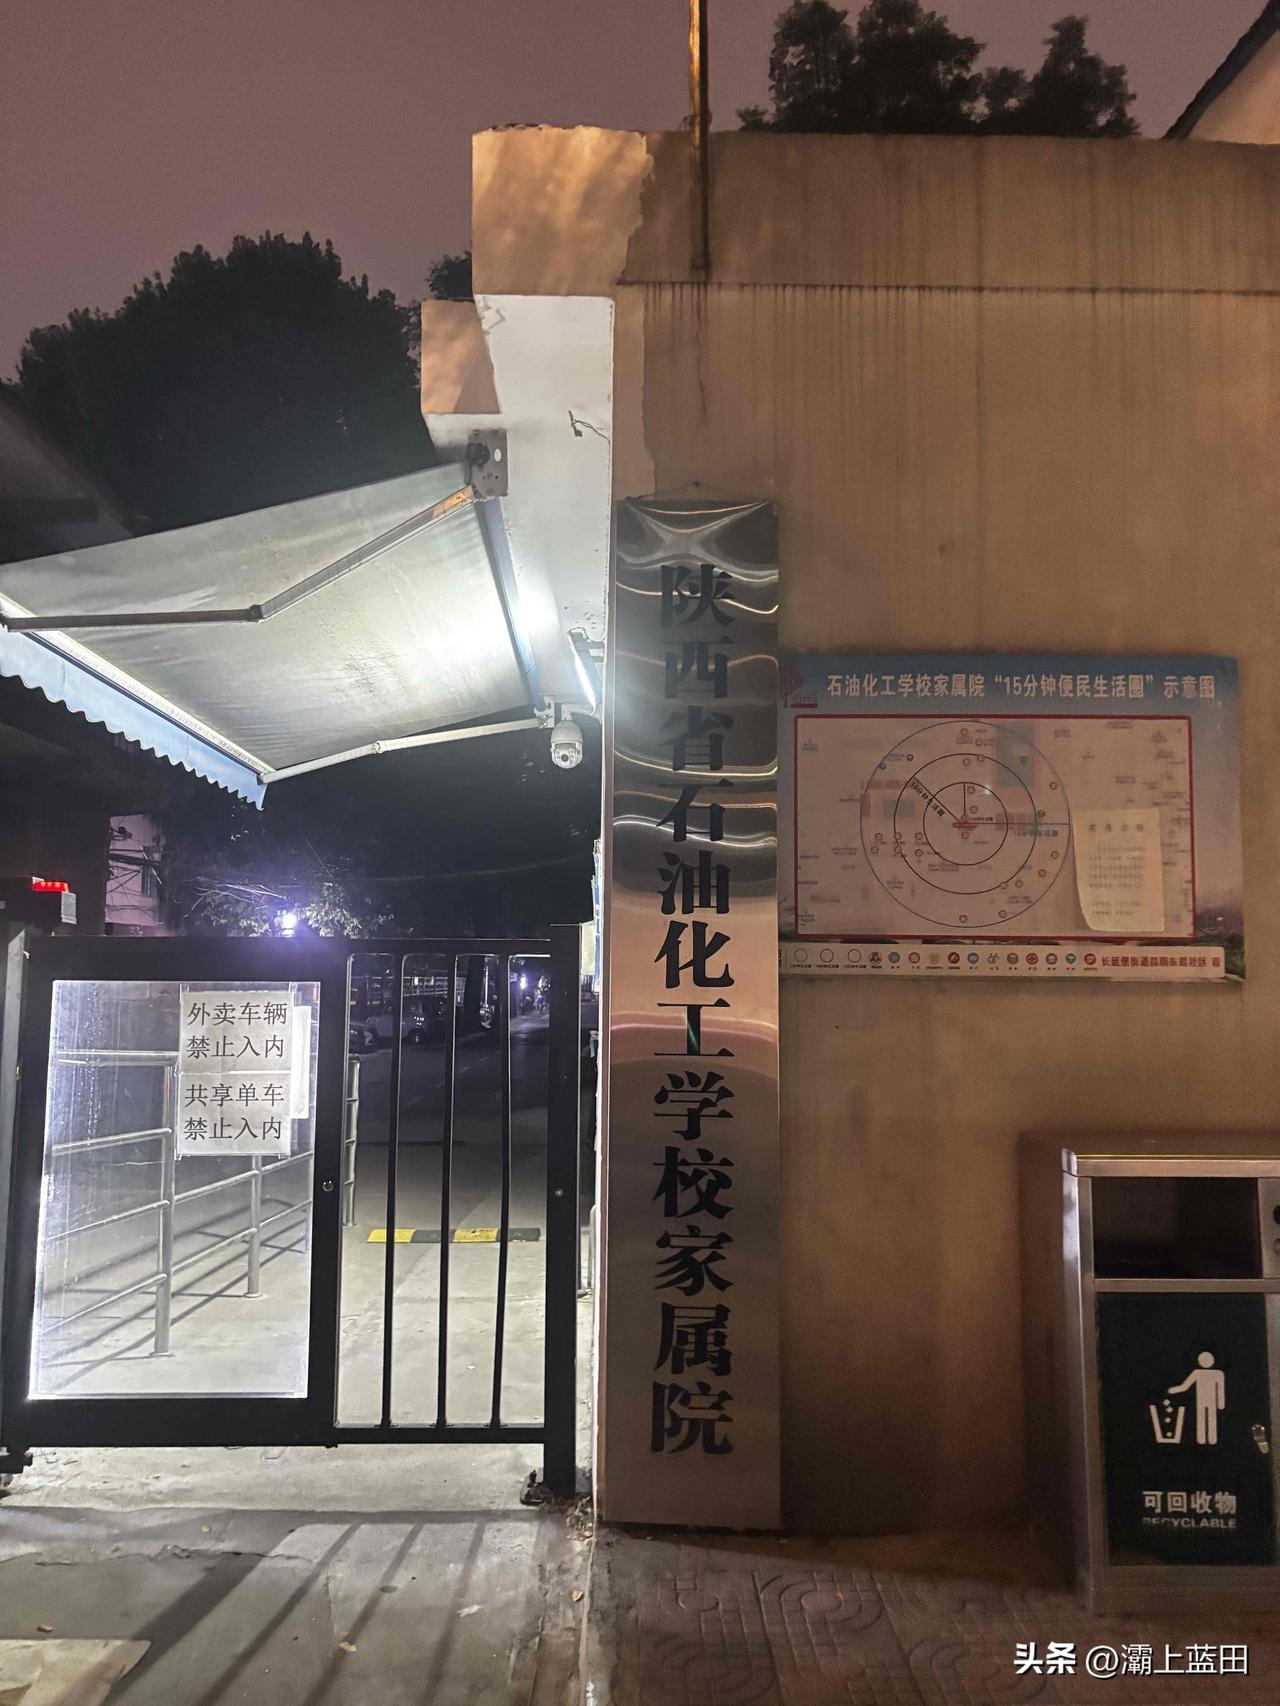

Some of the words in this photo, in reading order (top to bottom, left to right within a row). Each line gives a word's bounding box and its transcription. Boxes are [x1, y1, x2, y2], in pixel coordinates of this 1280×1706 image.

[187, 1001, 288, 1026] 外卖车辆
[651, 564, 736, 1455] 陕西省石油化工学校家属院
[186, 1034, 284, 1059] 禁止入内
[184, 1082, 285, 1108] 共享单车
[183, 1116, 282, 1141] 禁止入内
[1142, 1490, 1237, 1514] 可回收物
